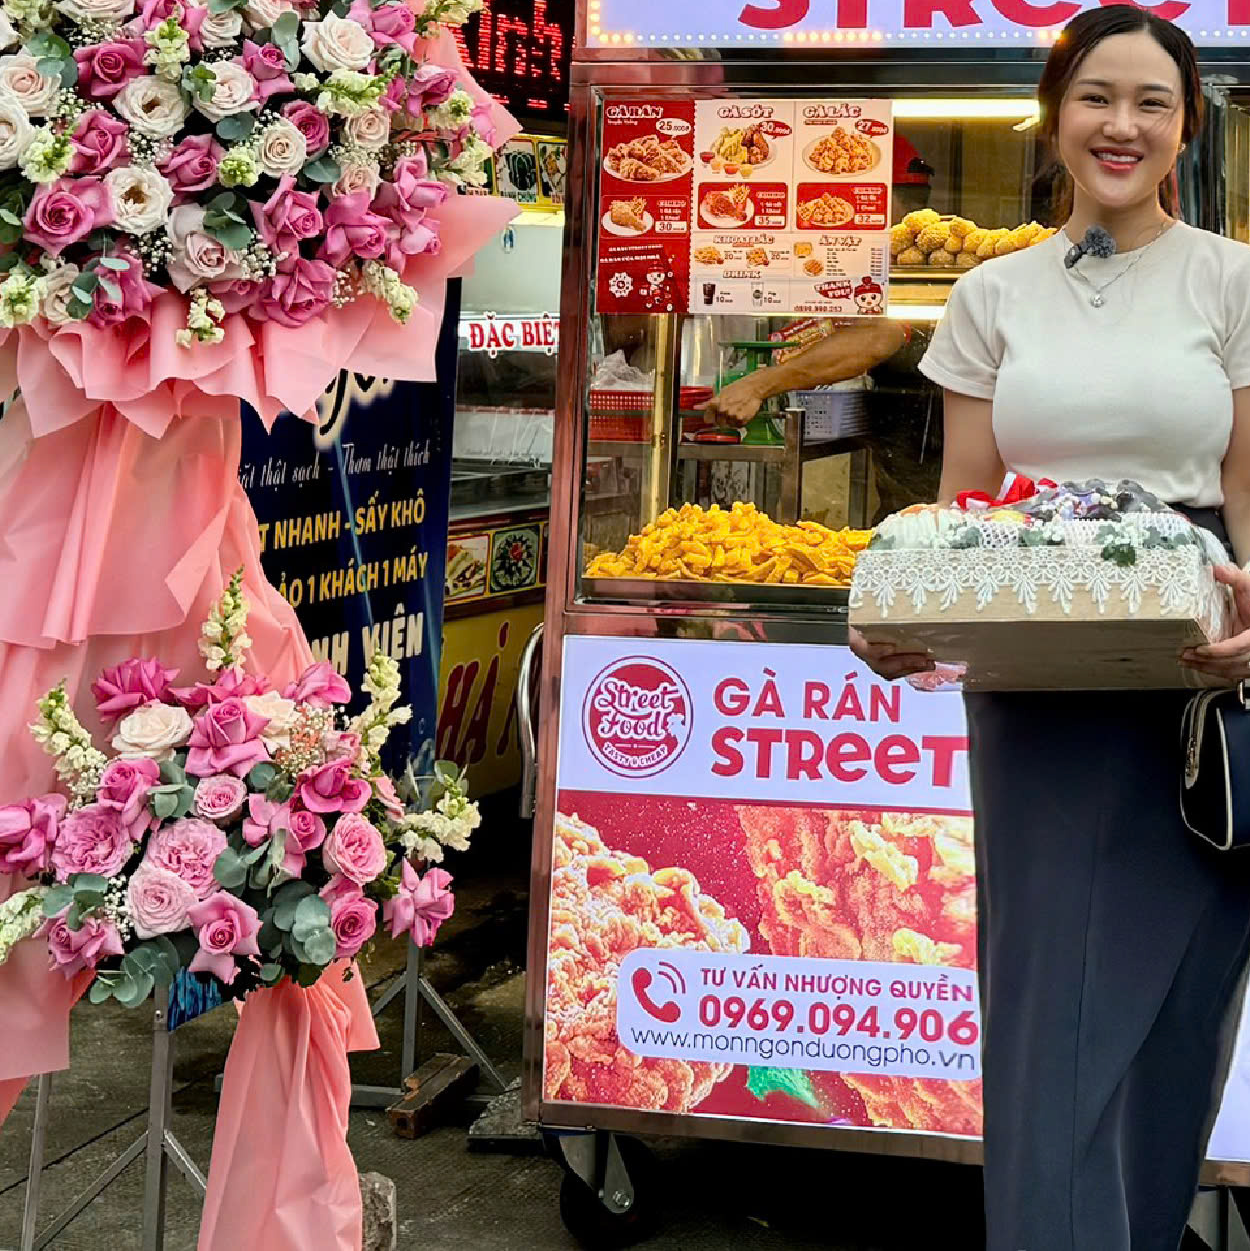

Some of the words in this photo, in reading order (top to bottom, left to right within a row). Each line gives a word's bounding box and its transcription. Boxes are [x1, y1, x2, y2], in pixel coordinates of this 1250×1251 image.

[469, 312, 514, 357] ĐẶC
[274, 510, 342, 550] NHANH
[354, 490, 388, 536] SẤY
[391, 487, 426, 529] KHÔ
[307, 574, 315, 605] 1
[319, 558, 379, 602] KHÁCH
[383, 560, 389, 588] 1
[393, 544, 429, 585] MÁY
[362, 603, 424, 670] VIÊN
[596, 681, 679, 711] Street
[714, 669, 785, 720] GÀ
[803, 672, 902, 723] RÁN
[599, 711, 665, 737] Food
[701, 966, 727, 986] TƯ
[732, 964, 777, 990] VẤN
[785, 972, 882, 1000] NHƯỢNG
[890, 974, 974, 1002] QUYỀN
[699, 993, 980, 1046] 0969.094.906
[631, 1027, 976, 1070] www.monngonduongpho.vn
